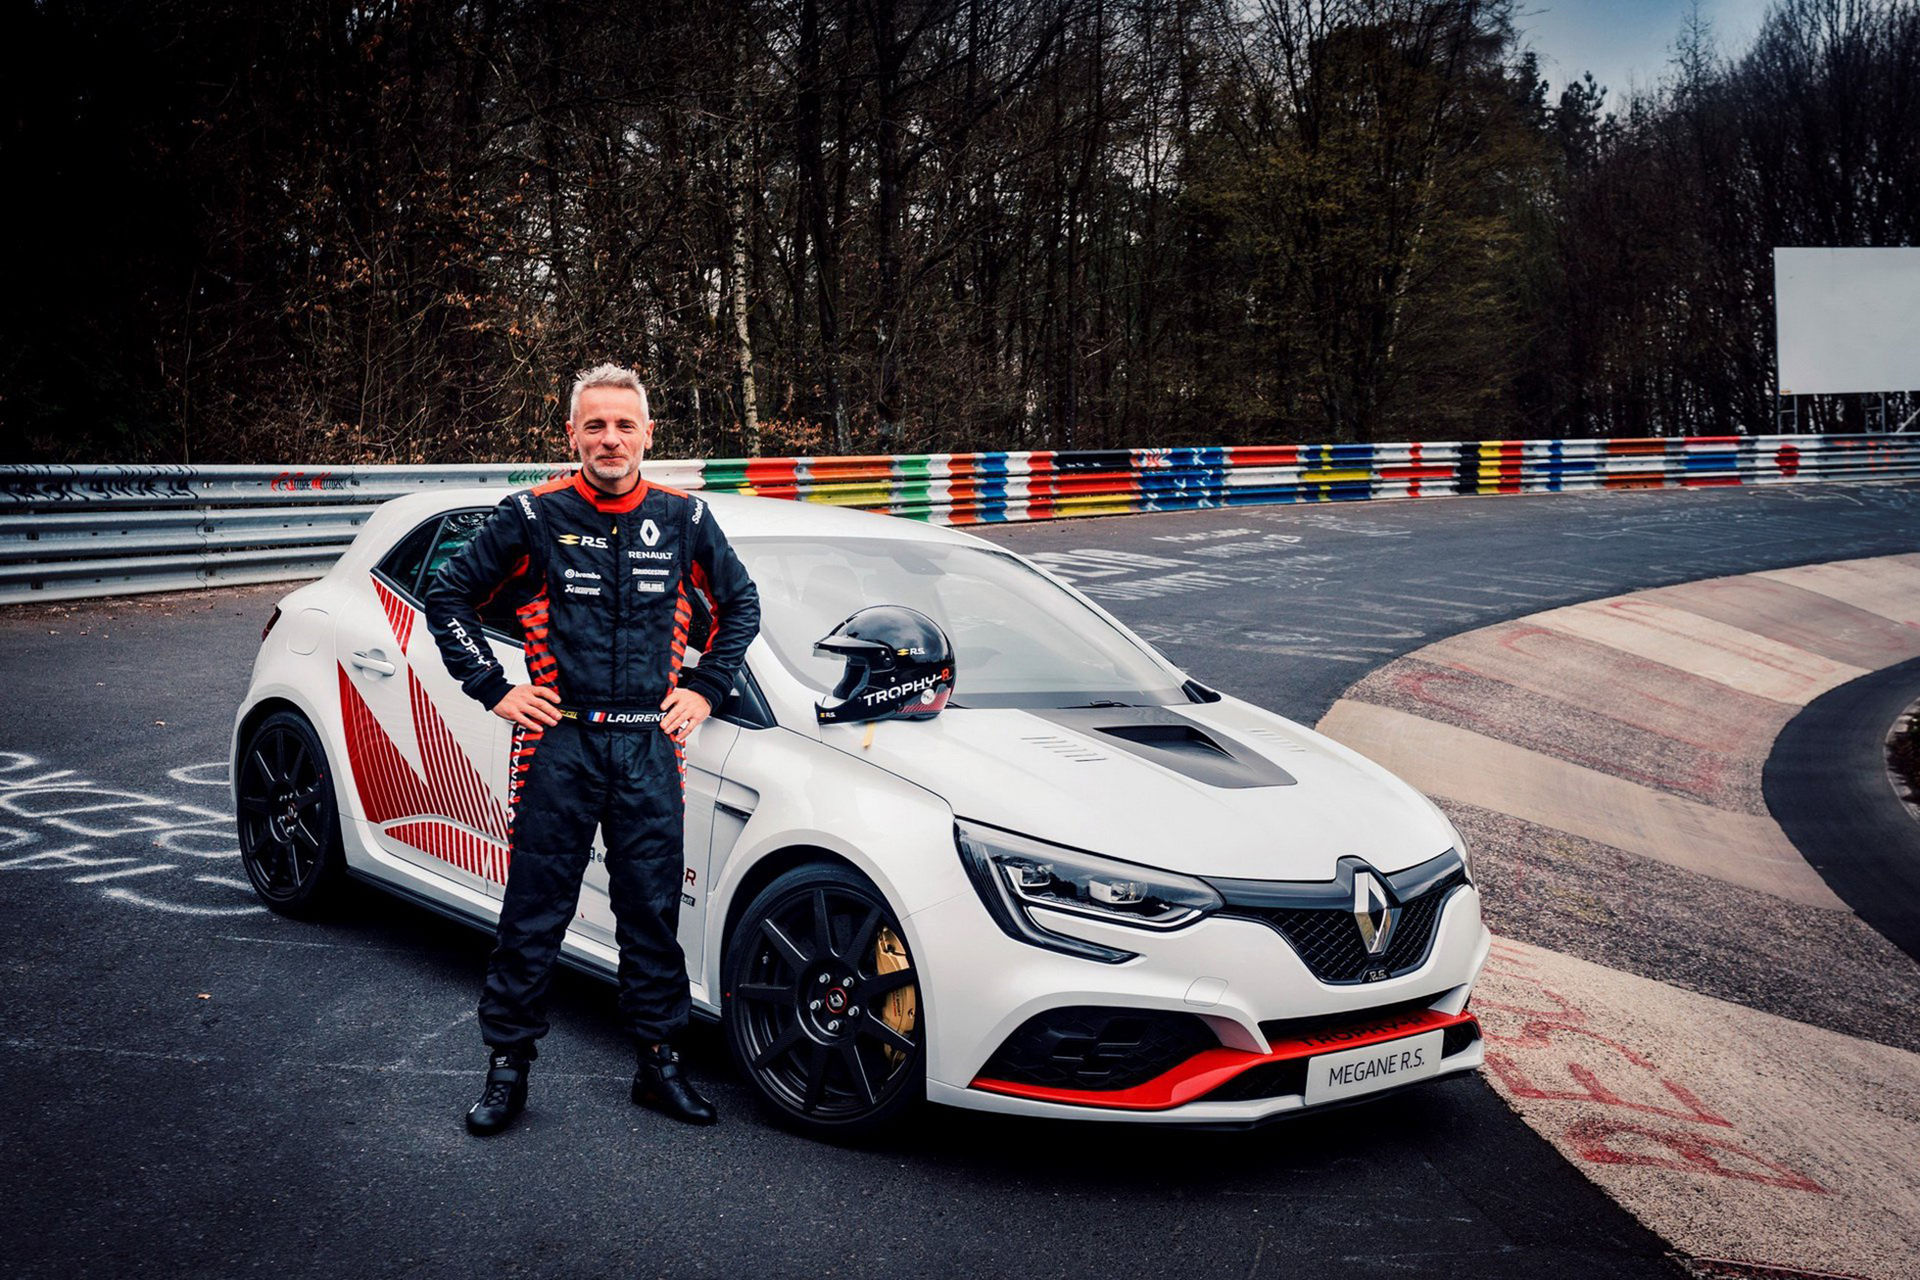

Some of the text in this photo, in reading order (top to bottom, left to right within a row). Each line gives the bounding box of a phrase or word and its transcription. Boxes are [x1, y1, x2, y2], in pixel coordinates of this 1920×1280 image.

[628, 550, 673, 560] RENAULT
[863, 668, 950, 706] TROPHY-R
[606, 711, 668, 723] LAURENT
[1328, 1047, 1425, 1087] MEGANE R.S.
